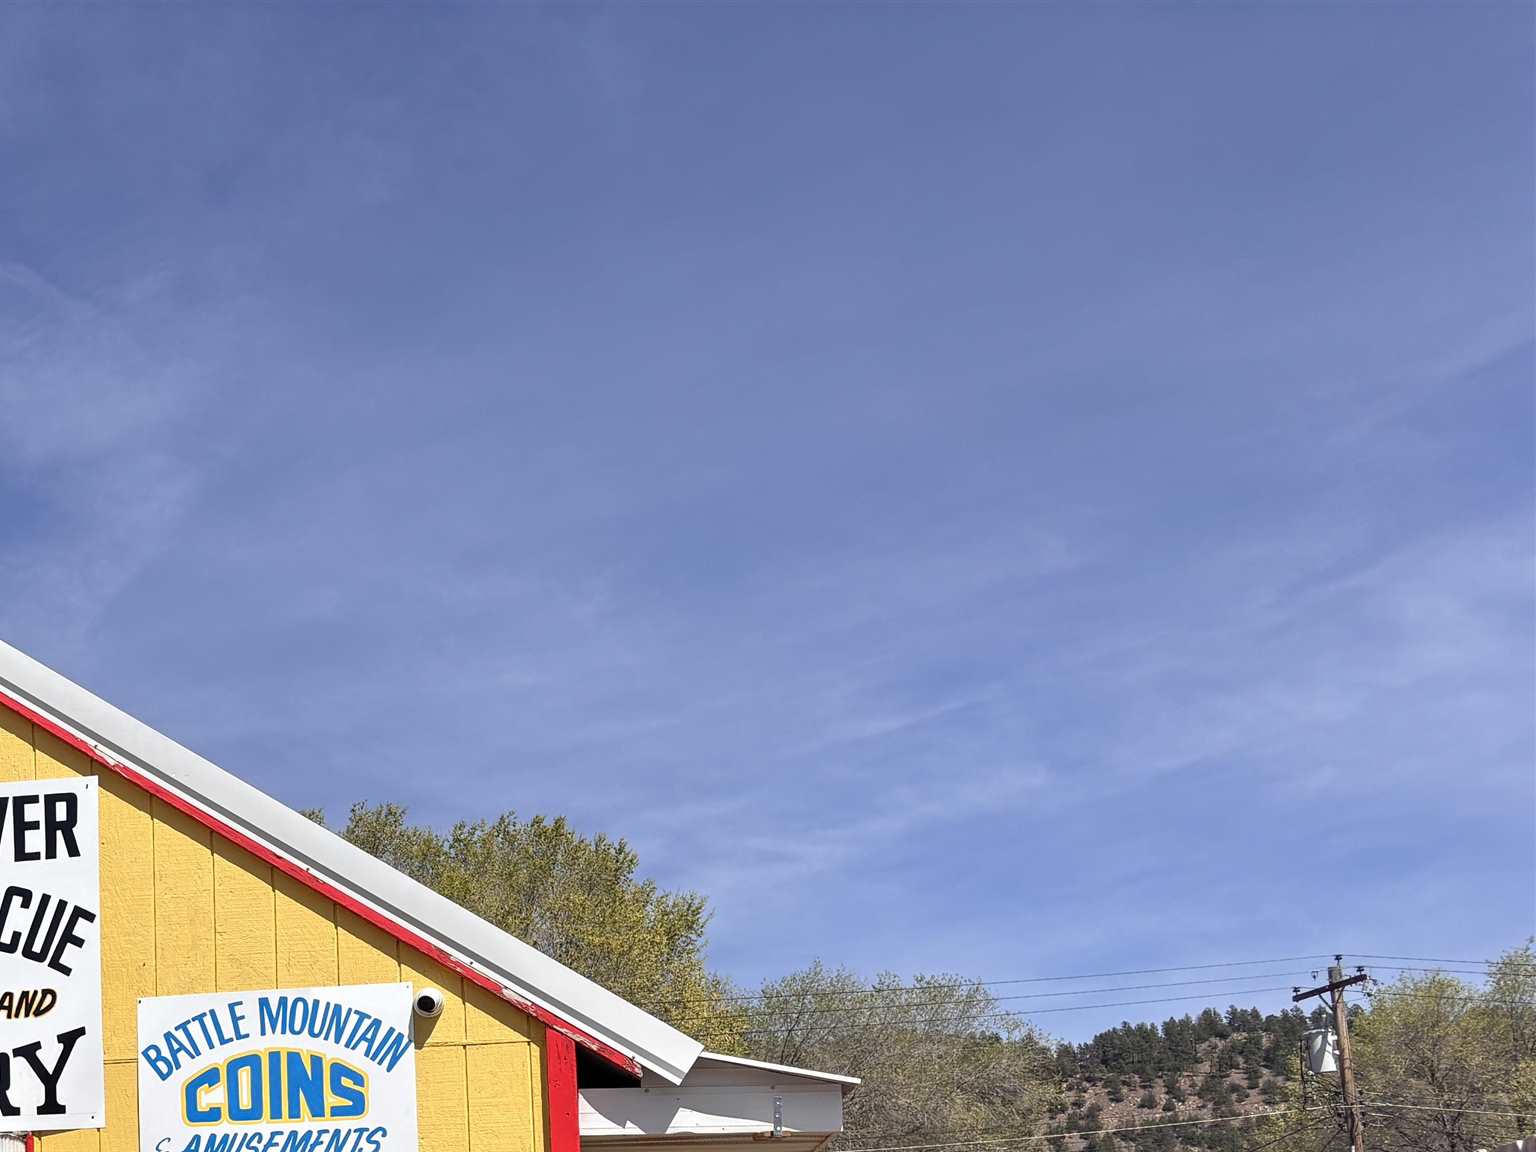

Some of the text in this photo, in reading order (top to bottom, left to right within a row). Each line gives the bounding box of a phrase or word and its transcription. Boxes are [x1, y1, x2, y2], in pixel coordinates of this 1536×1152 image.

[141, 995, 414, 1082] BATTLE MOUNTAIN
[184, 1050, 368, 1124] COINS
